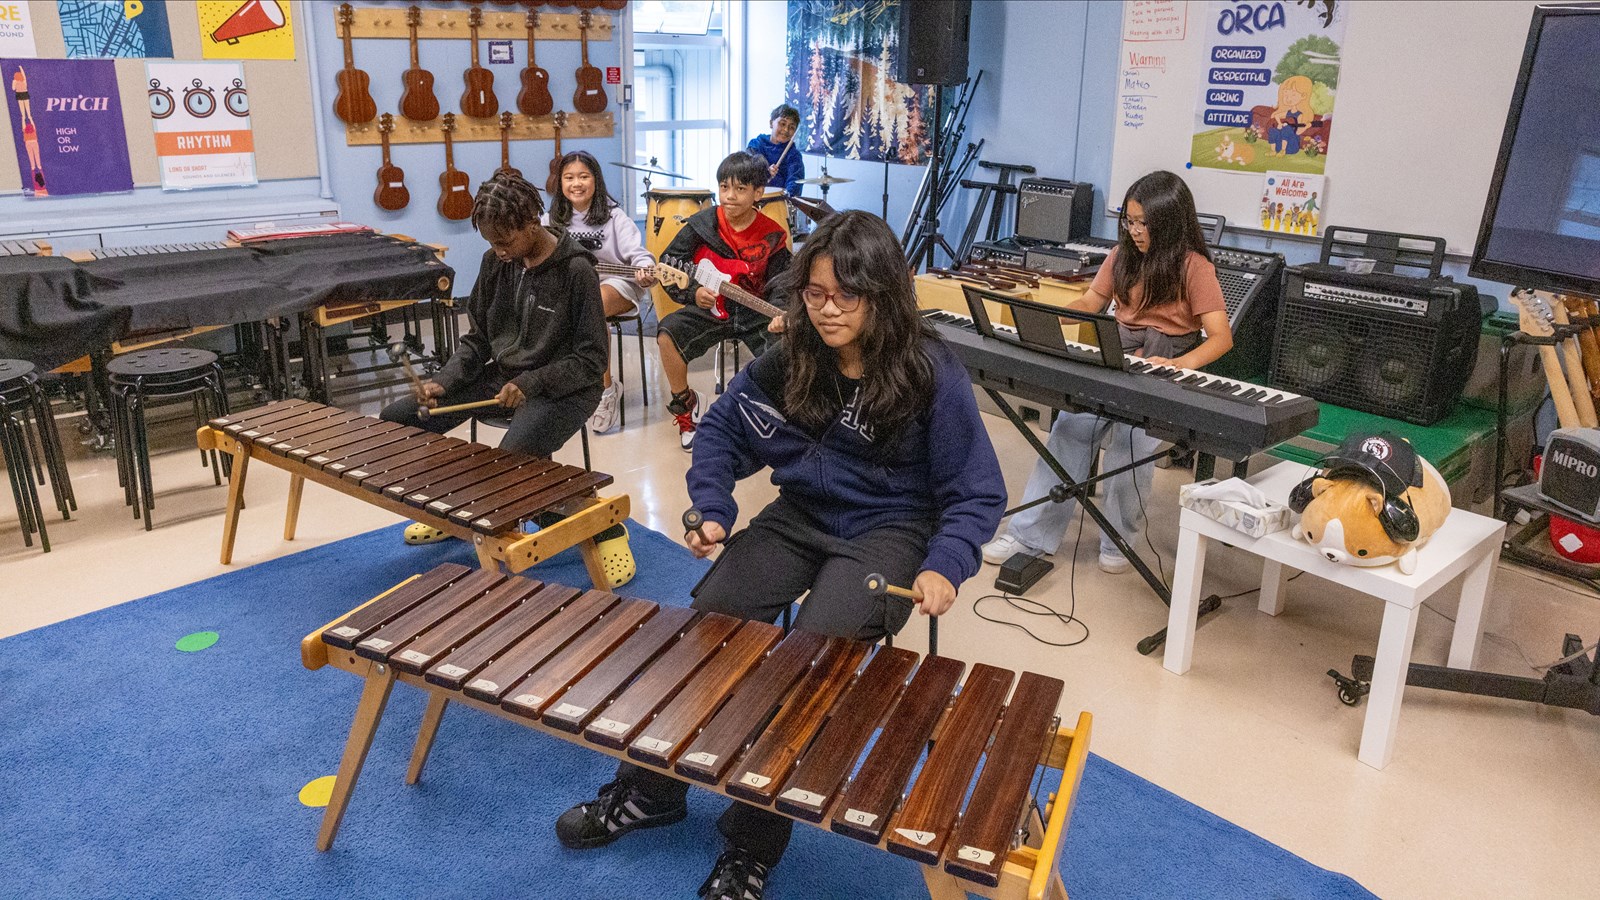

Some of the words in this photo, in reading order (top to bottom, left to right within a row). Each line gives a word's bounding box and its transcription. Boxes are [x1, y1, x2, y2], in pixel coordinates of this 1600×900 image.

[1217, 2, 1285, 35] ORCA
[1215, 49, 1262, 60] ORGANIZED
[1129, 51, 1166, 73] Warning
[1213, 71, 1266, 82] RESPECTFUL
[1210, 92, 1239, 103] CARING
[1207, 113, 1249, 124] ATTITUDE
[177, 134, 232, 149] RHYTHM
[59, 145, 79, 153] LOW
[1281, 179, 1290, 187] All
[1291, 180, 1305, 188] Are
[1275, 187, 1308, 199] Welcome
[1552, 450, 1598, 478] MIPRO
[700, 754, 709, 763] E
[751, 777, 760, 785] D
[802, 793, 809, 801] C
[856, 814, 866, 823] B
[915, 832, 924, 841] A
[971, 850, 981, 859] G
